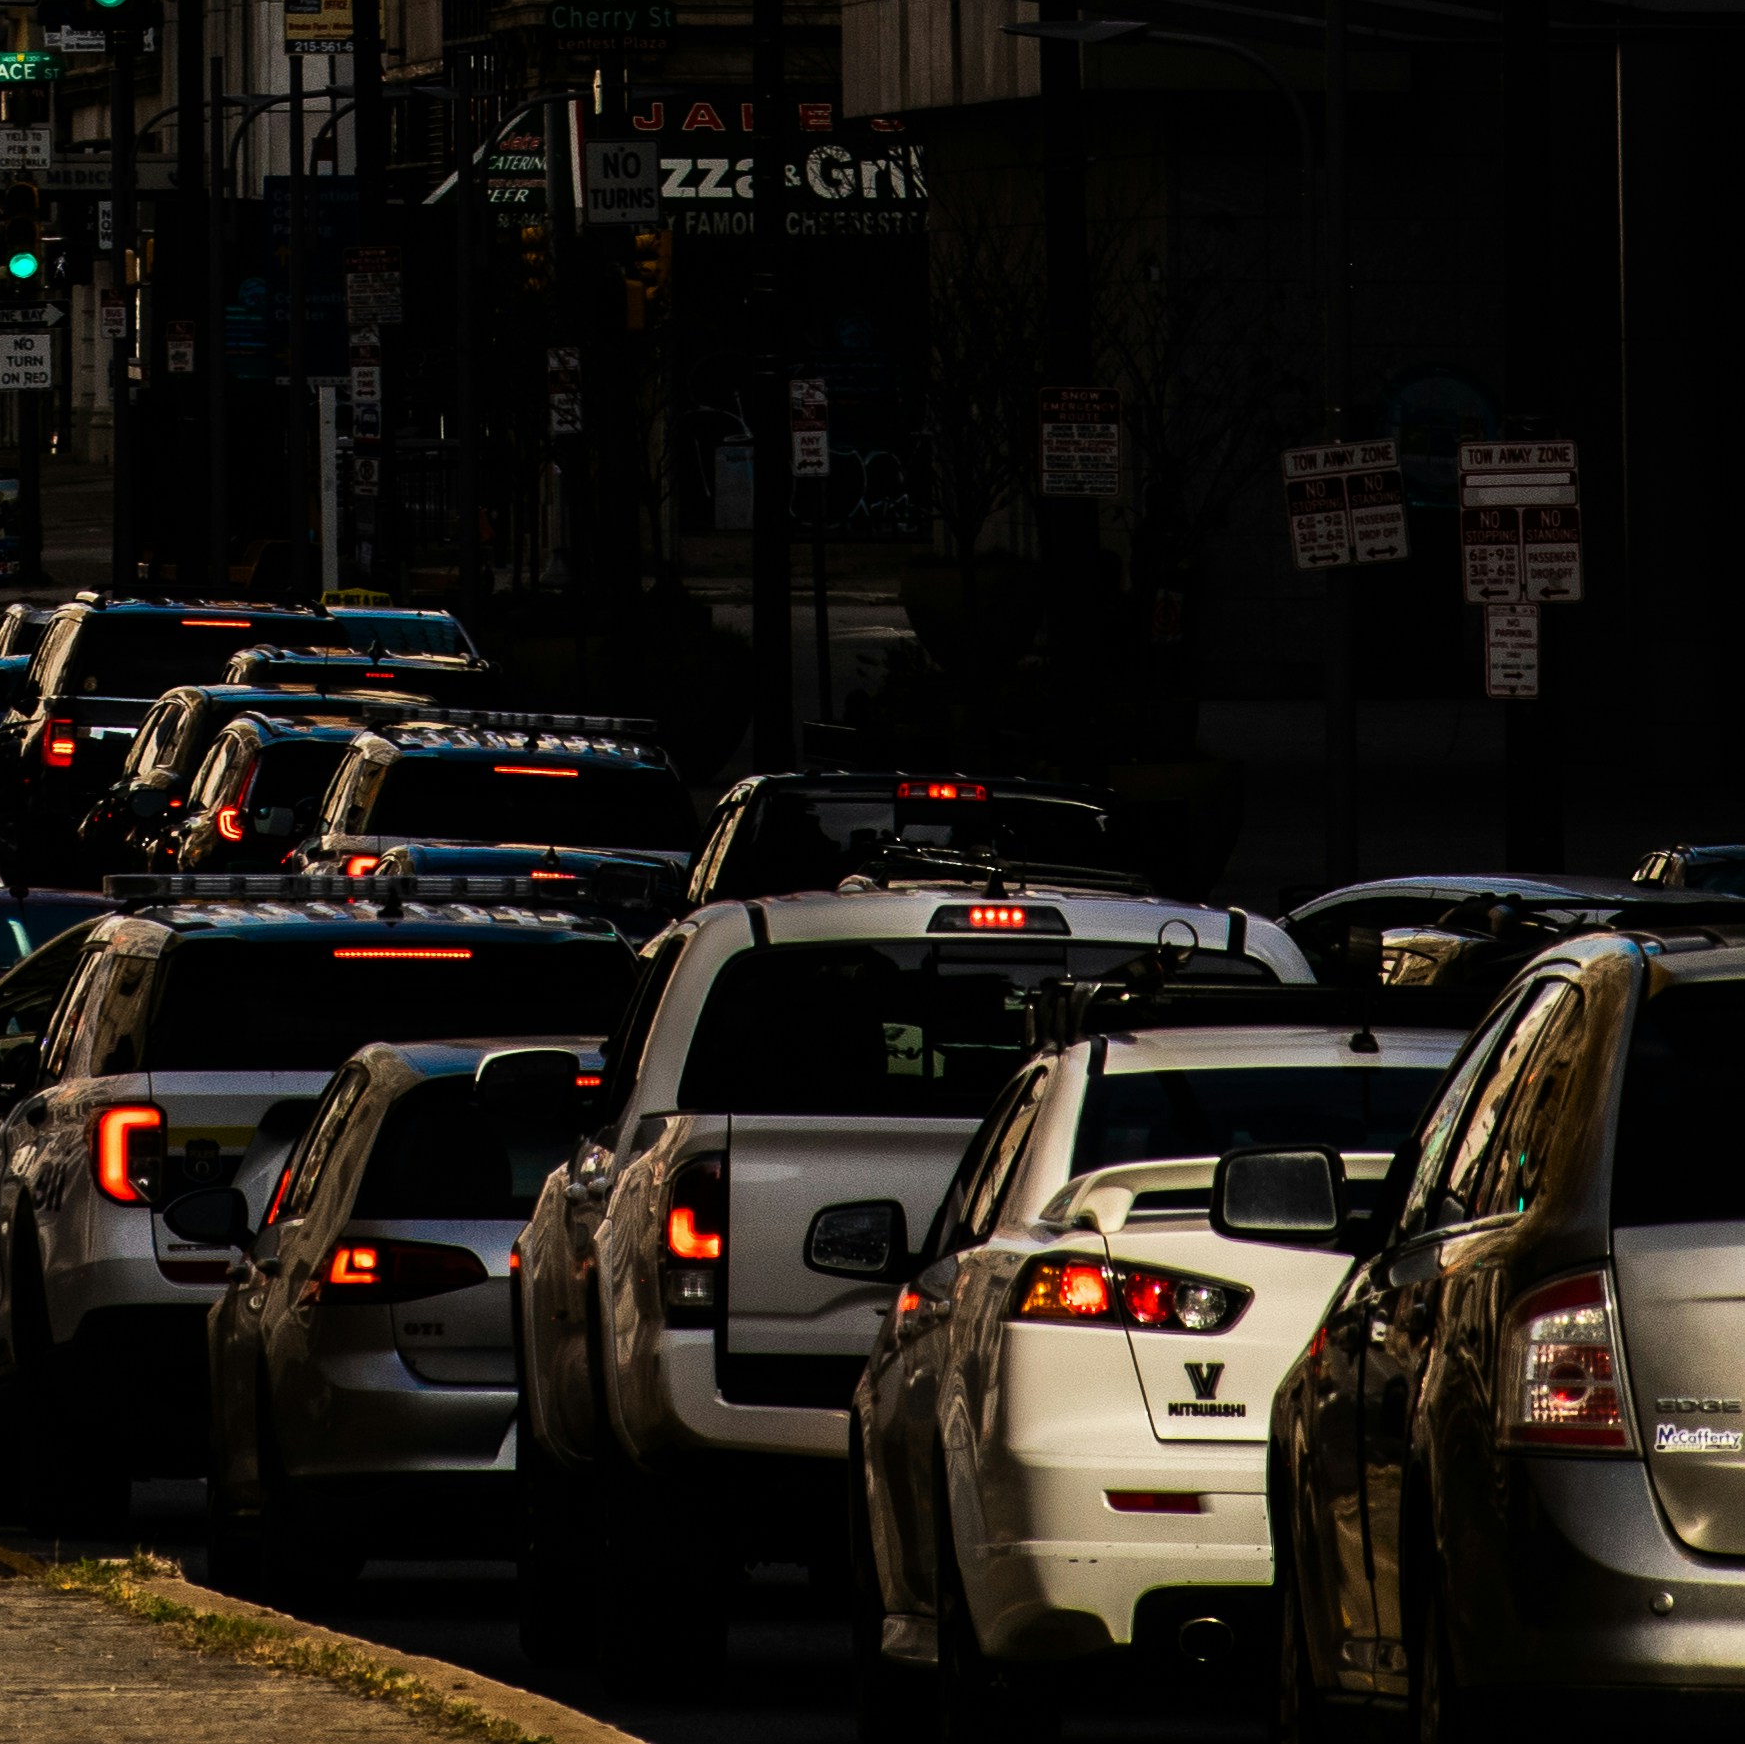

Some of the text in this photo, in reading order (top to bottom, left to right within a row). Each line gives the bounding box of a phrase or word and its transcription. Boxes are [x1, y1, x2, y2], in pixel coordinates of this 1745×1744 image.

[551, 5, 672, 30] Cherry St
[557, 36, 667, 50] Lenfest Plaza
[43, 66, 59, 79] ST
[631, 102, 906, 132] JAE
[6, 133, 42, 142] YIELD TO
[0, 158, 47, 168] CROSSWALK
[603, 152, 641, 178] NO
[47, 171, 112, 184] MEDIC
[487, 188, 530, 203] EER
[590, 188, 654, 209] TURNS
[21, 309, 44, 321] WAY
[13, 339, 34, 351] NO
[6, 356, 44, 368] TURN
[1, 371, 48, 385] ON RED
[1060, 391, 1100, 401] SNOW
[1042, 401, 1116, 411] EMERGENCY
[1059, 412, 1101, 422] ROUTE
[1291, 444, 1392, 470] TOW AWAY ZONE
[1468, 447, 1571, 464] TOW AWAY ZONE
[1305, 480, 1327, 498] NO
[1363, 473, 1385, 492] NO
[1291, 495, 1345, 512] STOPPING
[1351, 491, 1401, 508] STANDING
[1356, 512, 1401, 525] PASSENGER
[1479, 511, 1501, 529] NO
[1540, 510, 1561, 527] NO
[1359, 529, 1381, 540] DROP
[1465, 529, 1518, 543] STOPPING
[1526, 529, 1578, 542] STANDING
[1528, 552, 1577, 563] PASSENGER
[1507, 619, 1520, 627] NO
[1495, 629, 1532, 638] PARKING
[404, 1323, 442, 1335] GTI
[1168, 1402, 1246, 1417] MITSUBISHI
[1656, 1398, 1743, 1413] EDGE
[1658, 1426, 1740, 1446] McCafferty
